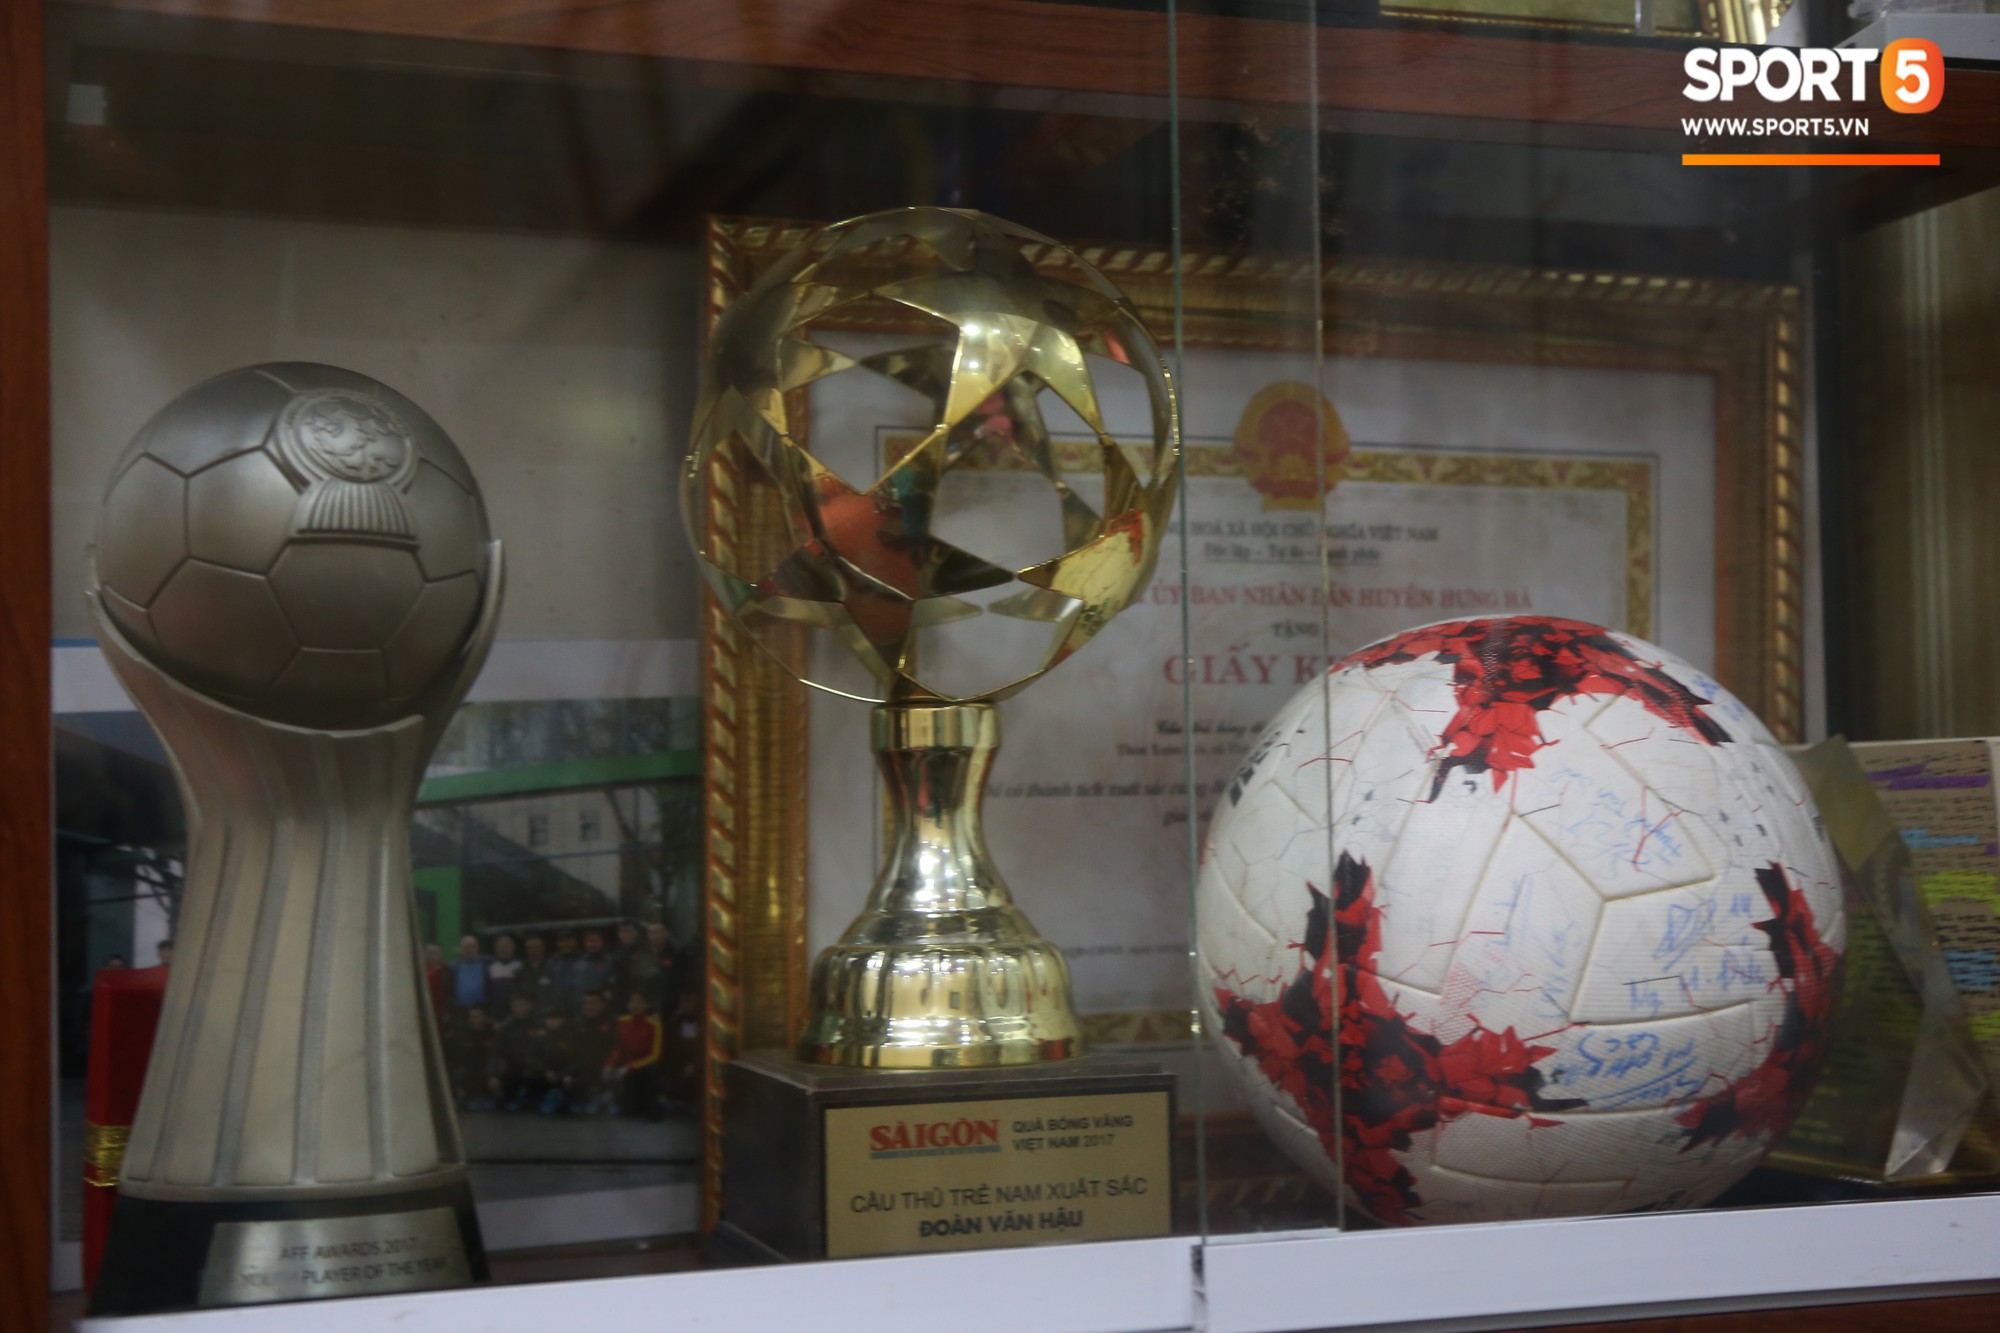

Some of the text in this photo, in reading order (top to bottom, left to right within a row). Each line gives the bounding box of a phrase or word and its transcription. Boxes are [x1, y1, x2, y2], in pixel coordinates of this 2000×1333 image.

[1164, 642, 1279, 686] GIẤY
[1047, 1116, 1089, 1132] BÓNG
[1092, 1113, 1134, 1130] VÀNG
[1012, 1134, 1115, 1153] VIỆT NAM 2017
[850, 1191, 895, 1213] CẦU
[902, 1187, 943, 1209] THỦ
[996, 1184, 1042, 1204] NAM
[1047, 1177, 1101, 1201] XUẤT
[1105, 1174, 1148, 1197] SẮC
[919, 1207, 1084, 1238] ĐOÀN VĂN HẬU
[302, 1265, 359, 1284] PLAYER
